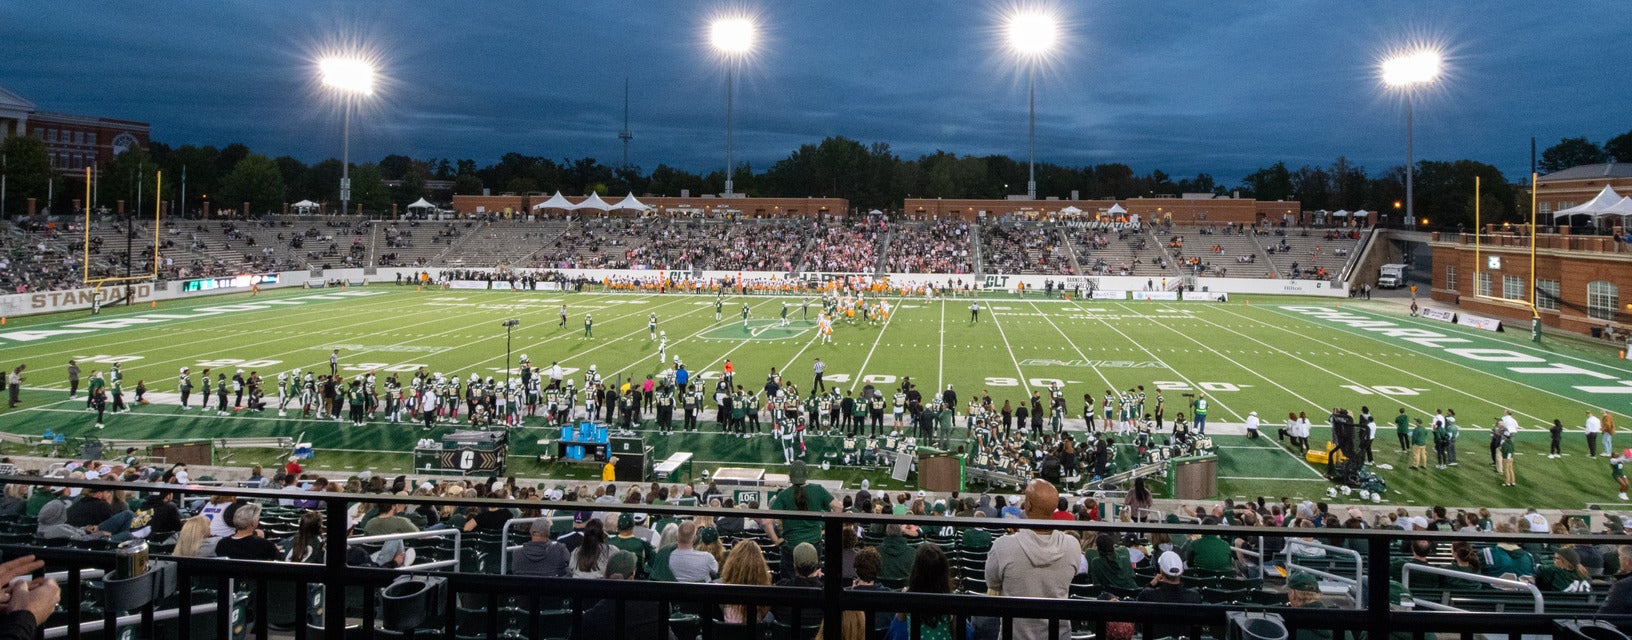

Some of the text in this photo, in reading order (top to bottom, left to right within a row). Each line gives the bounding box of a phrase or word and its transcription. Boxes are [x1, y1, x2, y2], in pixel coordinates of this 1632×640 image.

[1099, 221, 1141, 229] NATION
[31, 285, 150, 309] STANDAD
[1152, 380, 1242, 392] 20
[1339, 384, 1420, 396] 10
[740, 493, 755, 502] 106
